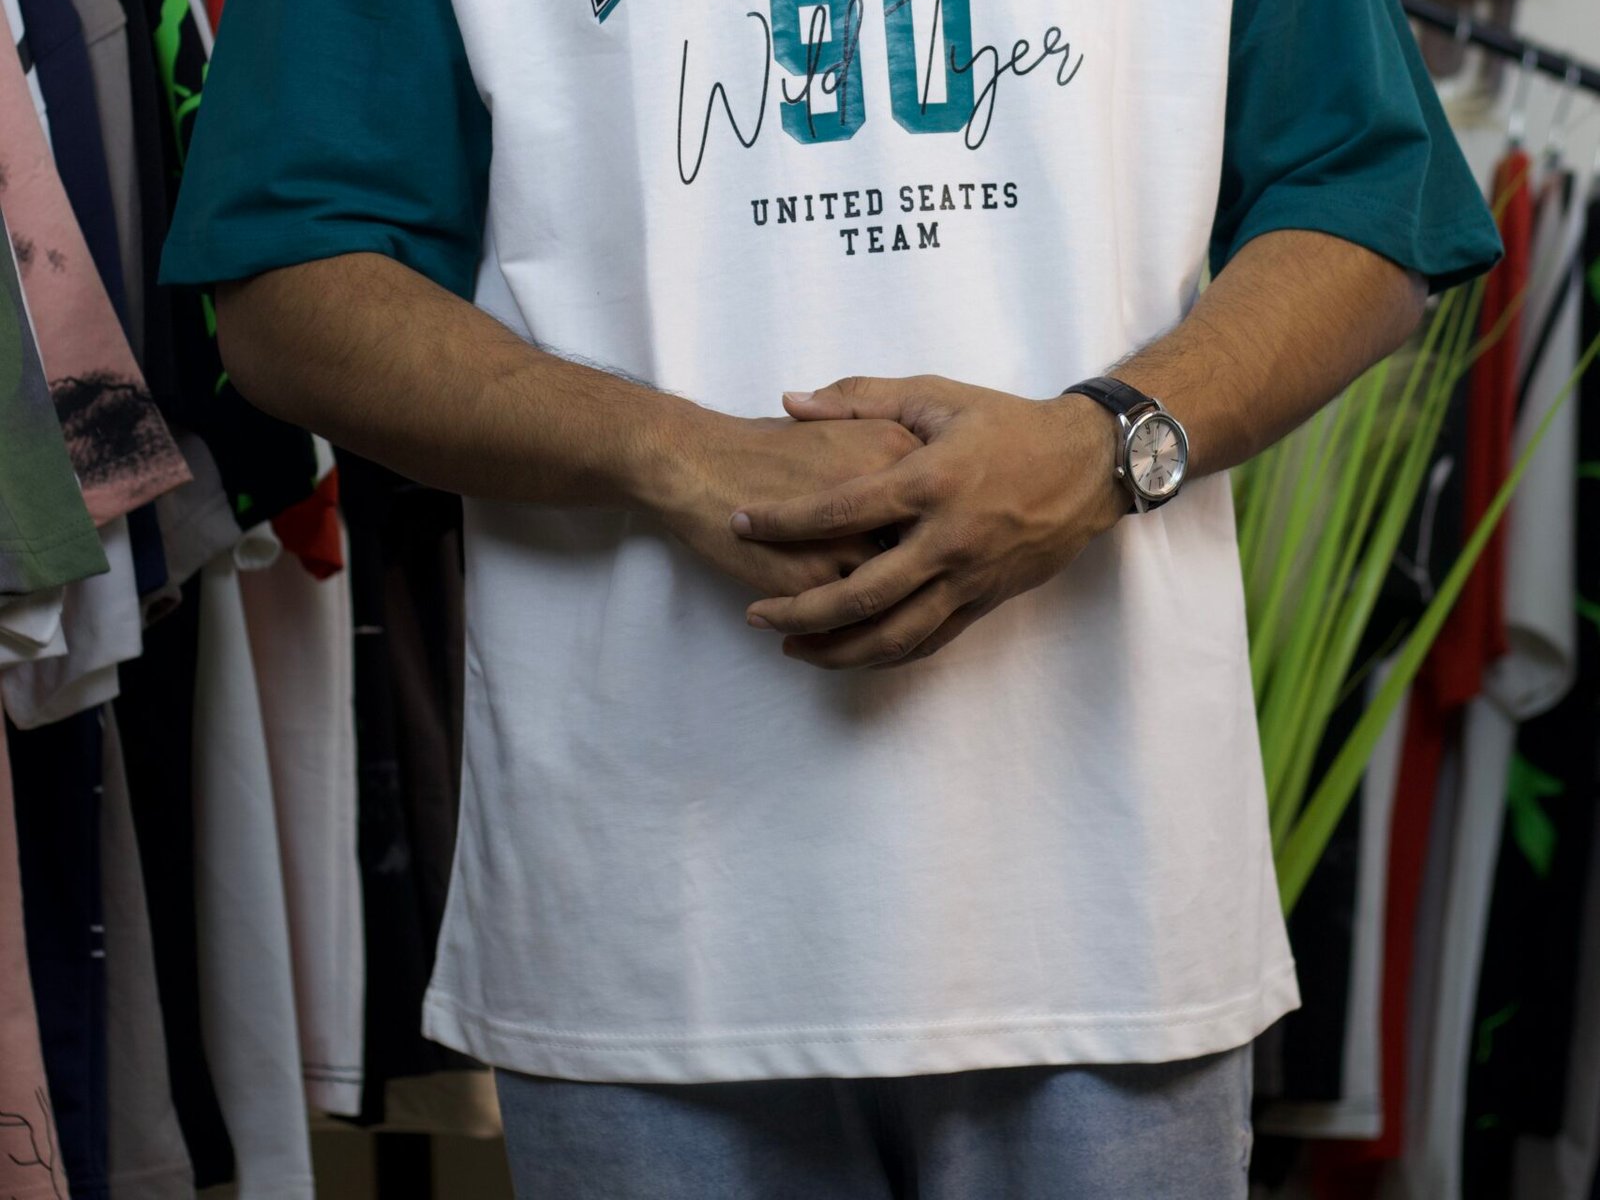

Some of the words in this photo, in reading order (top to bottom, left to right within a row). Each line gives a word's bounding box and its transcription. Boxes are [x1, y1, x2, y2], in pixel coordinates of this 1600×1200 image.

[751, 188, 884, 226] UNITED
[899, 181, 1019, 213] SEATES
[840, 221, 941, 256] TEAM
